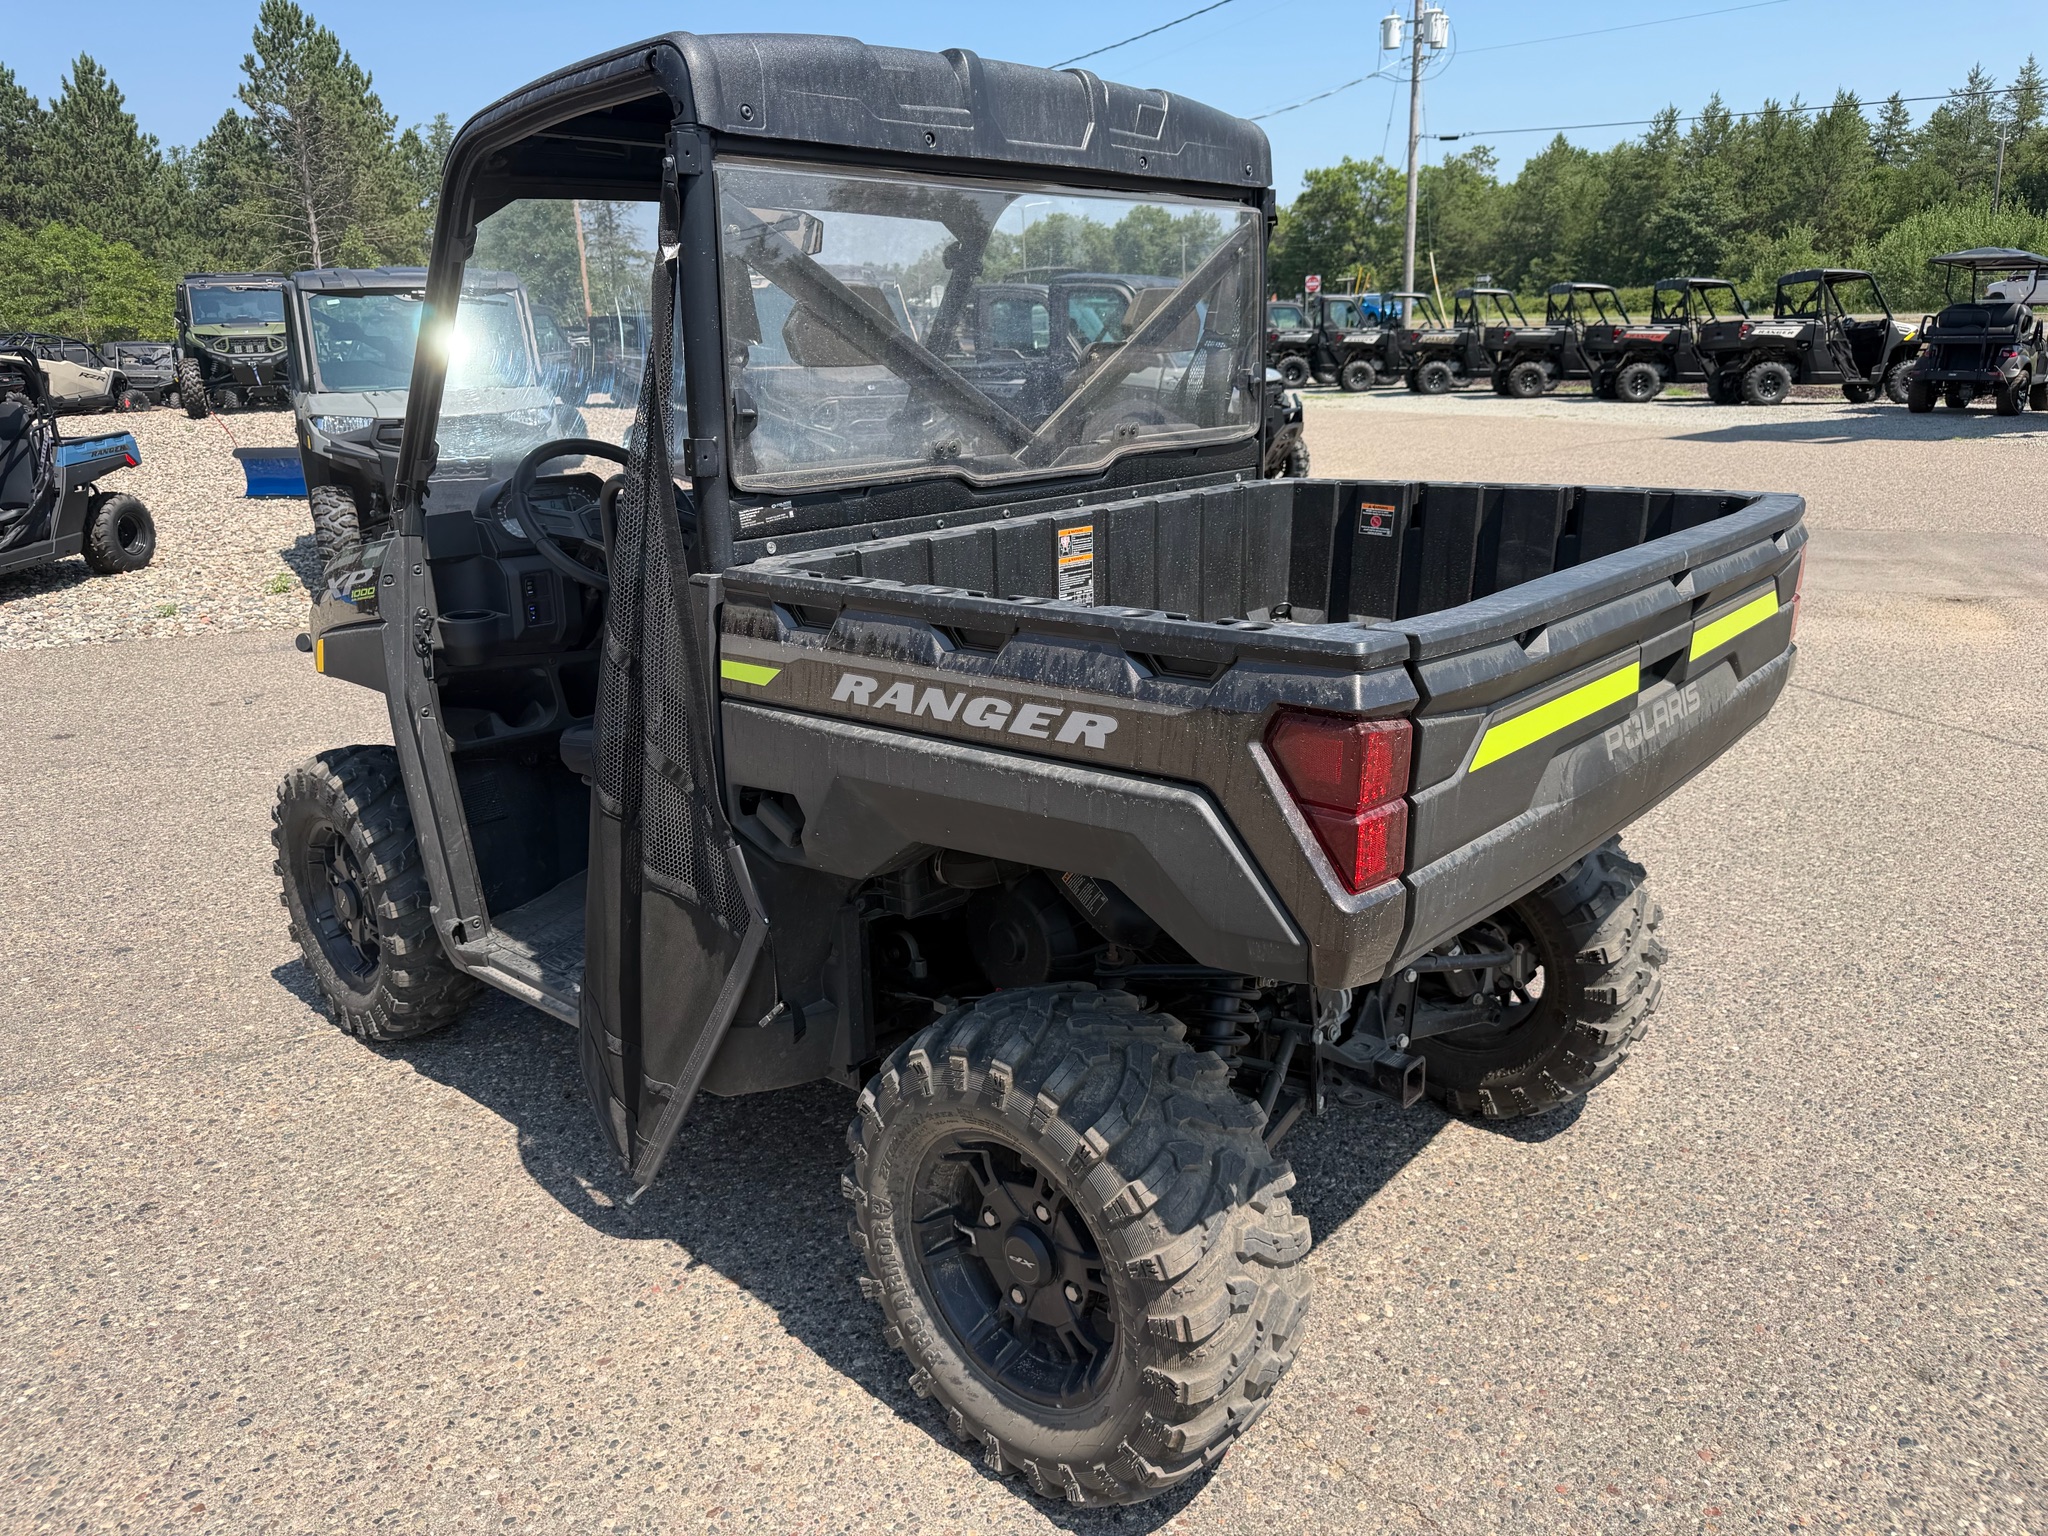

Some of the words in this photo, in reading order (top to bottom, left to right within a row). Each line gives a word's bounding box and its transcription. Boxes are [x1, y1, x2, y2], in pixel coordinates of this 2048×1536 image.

[78, 371, 106, 382] RZR
[90, 444, 126, 458] RANGER
[327, 568, 374, 599] XP
[351, 586, 376, 598] 1000
[831, 672, 1119, 750] RANGER
[1603, 681, 1702, 762] POLARIS
[872, 1220, 915, 1311] ARMOR
[904, 1313, 943, 1368] PRO
